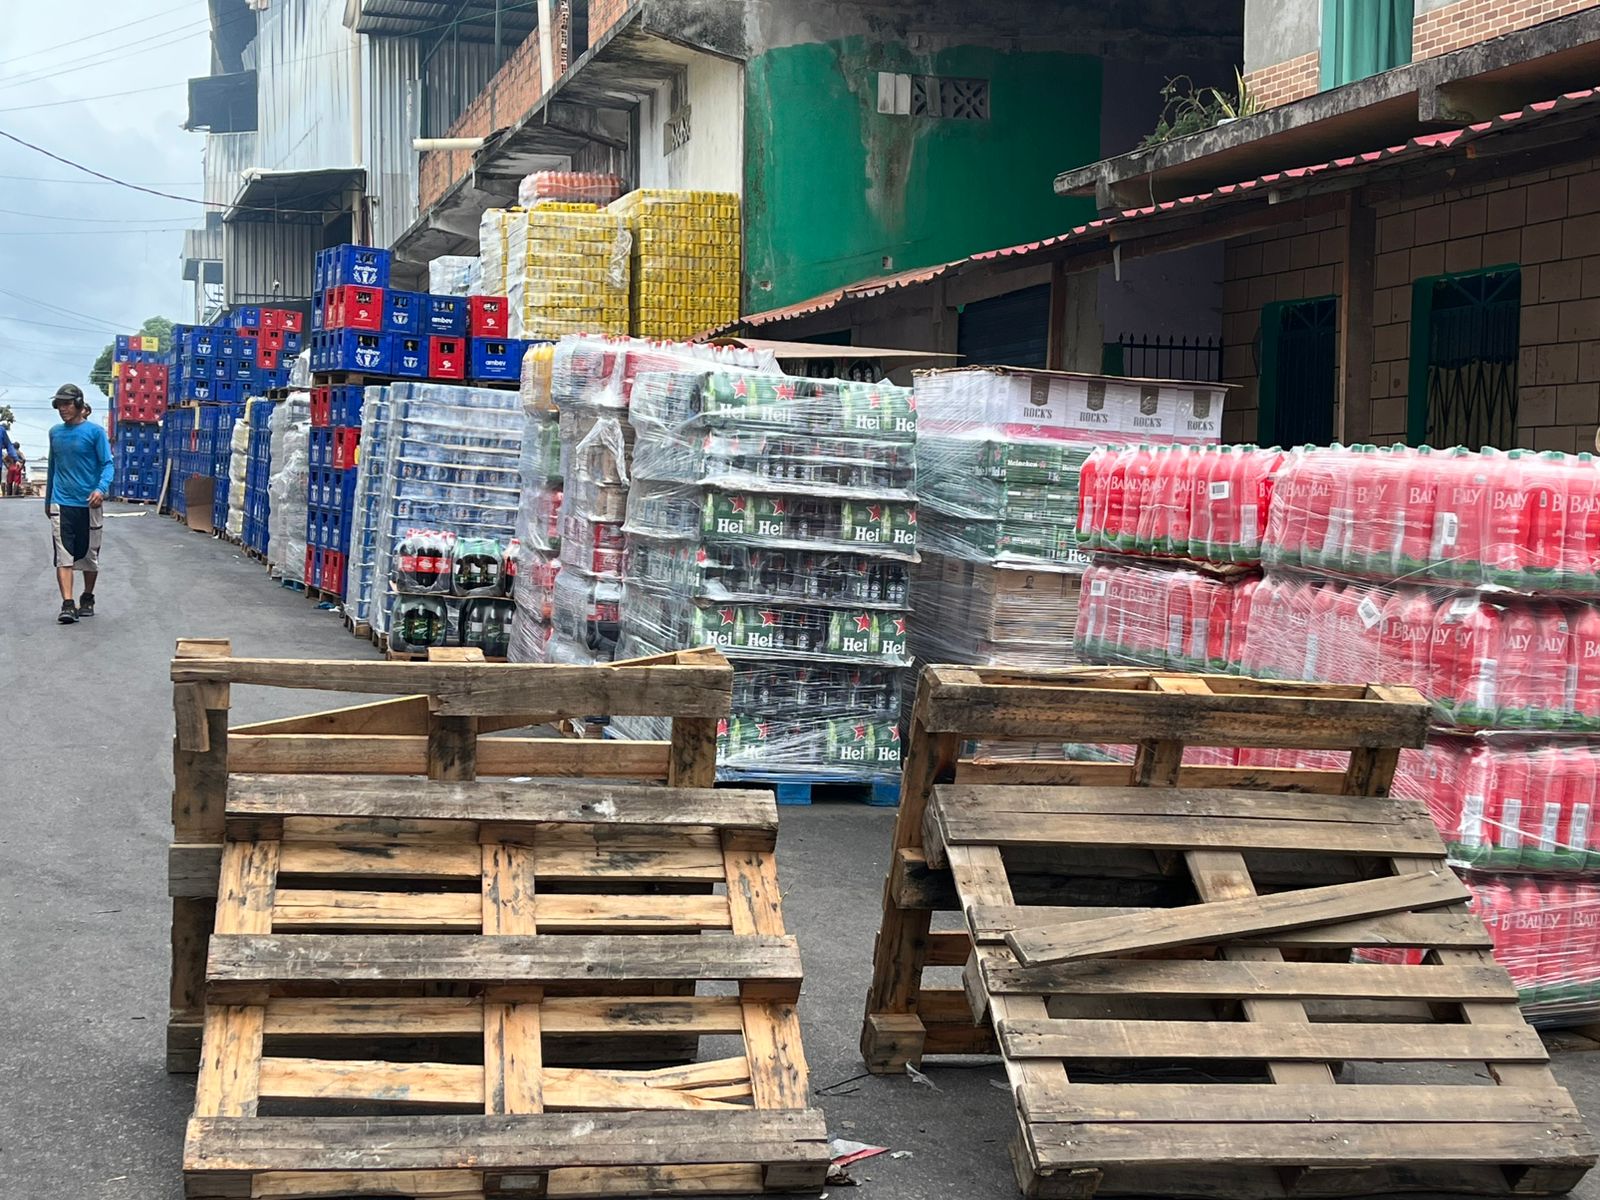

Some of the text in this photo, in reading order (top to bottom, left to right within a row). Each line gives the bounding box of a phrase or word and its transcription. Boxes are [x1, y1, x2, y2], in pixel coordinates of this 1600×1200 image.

[856, 414, 880, 429] Hei
[1493, 491, 1530, 511] BALY
[717, 518, 783, 536] Hei Hei
[854, 526, 917, 545] Hei Hei
[706, 630, 773, 648] Hei Hei
[842, 637, 905, 655] Hei Hei
[840, 746, 901, 761] Hei Hei
